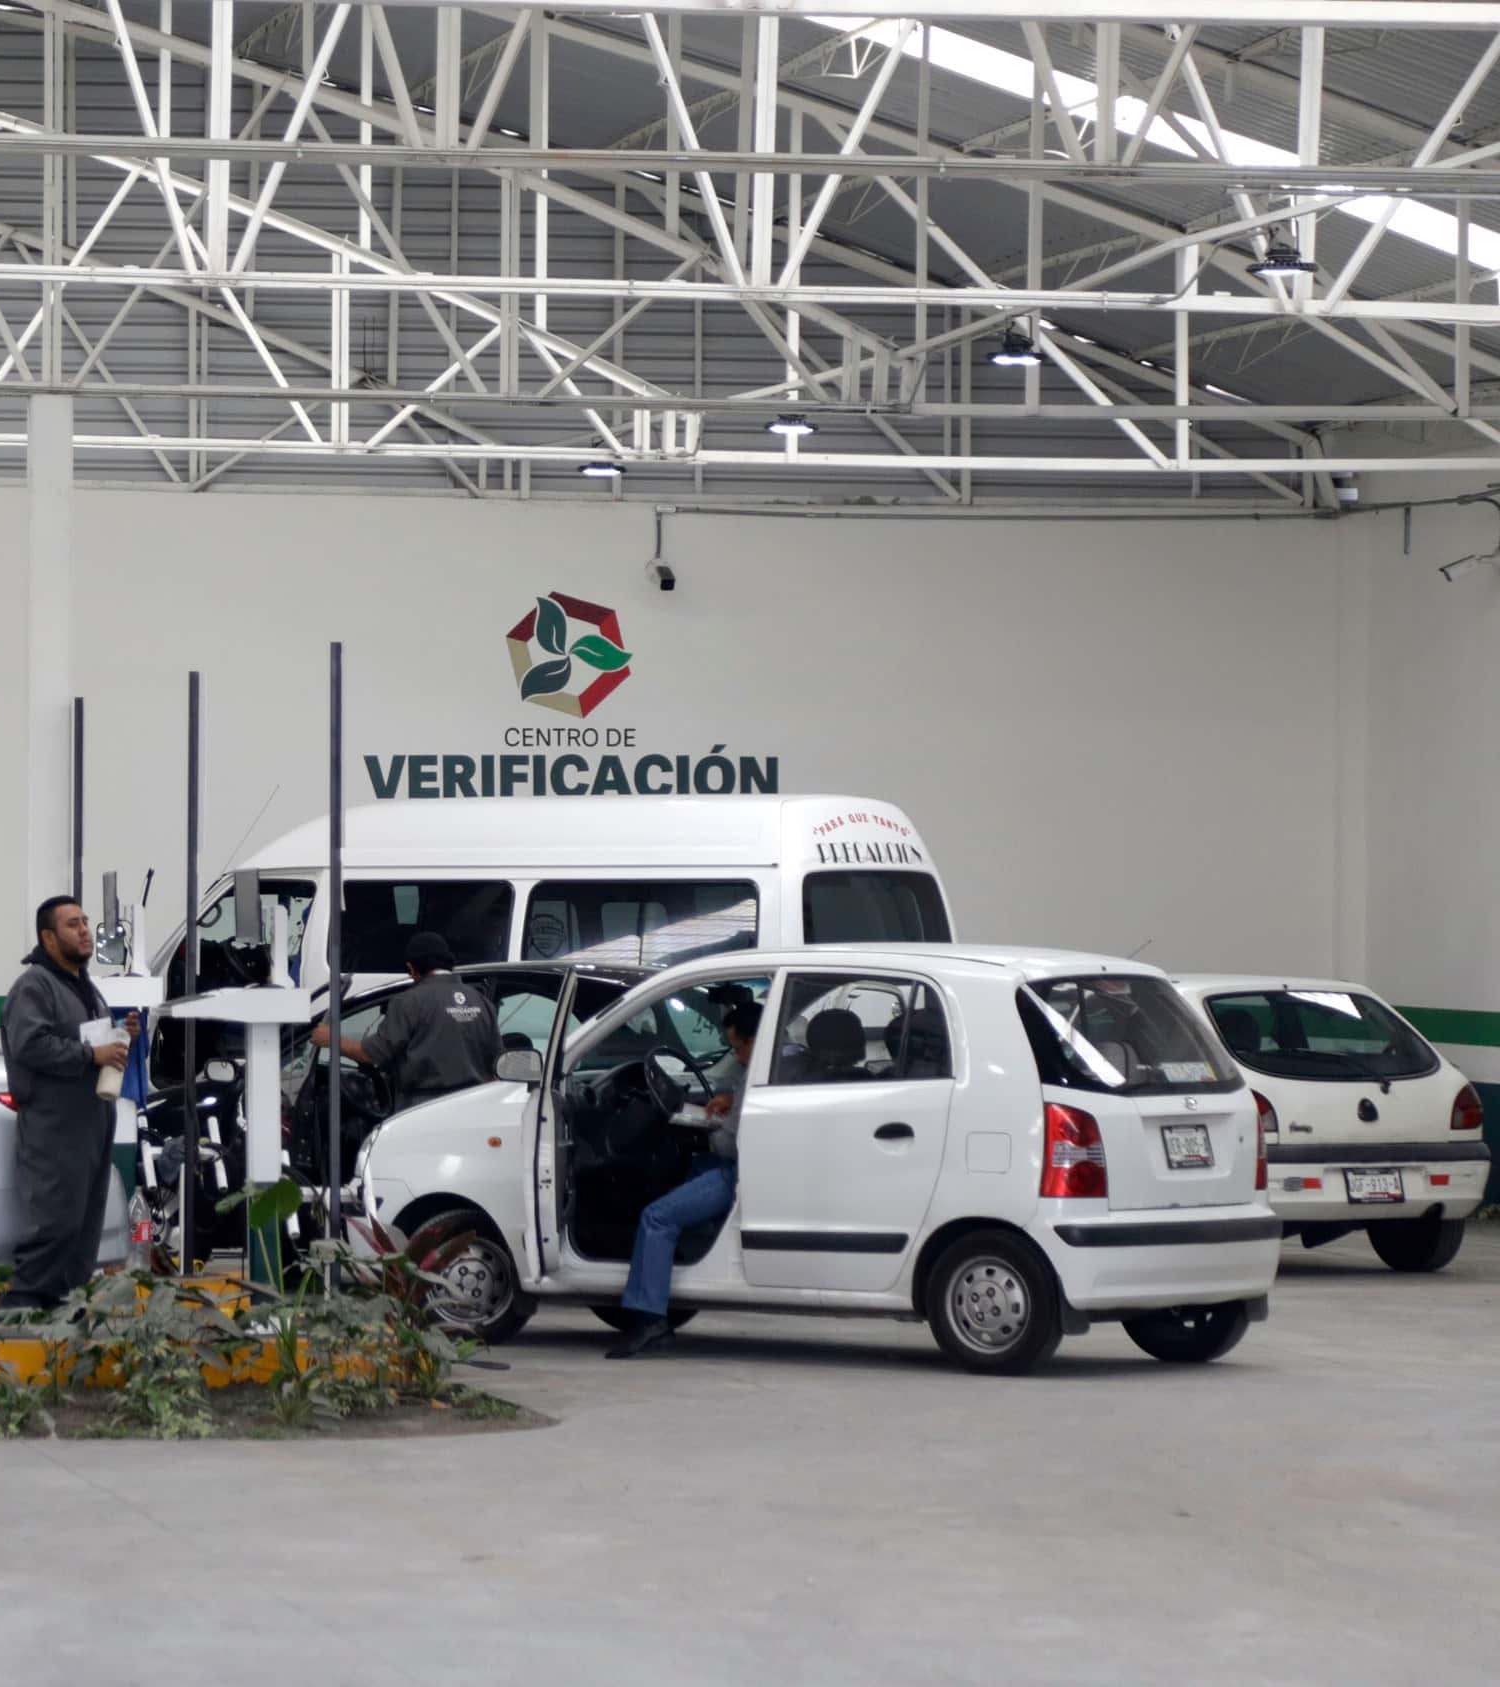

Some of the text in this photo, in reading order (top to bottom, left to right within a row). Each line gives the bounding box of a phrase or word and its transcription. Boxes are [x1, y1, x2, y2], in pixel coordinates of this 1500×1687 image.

[504, 727, 636, 747] CENTRO DE
[363, 744, 779, 799] VERIFICACIÓN
